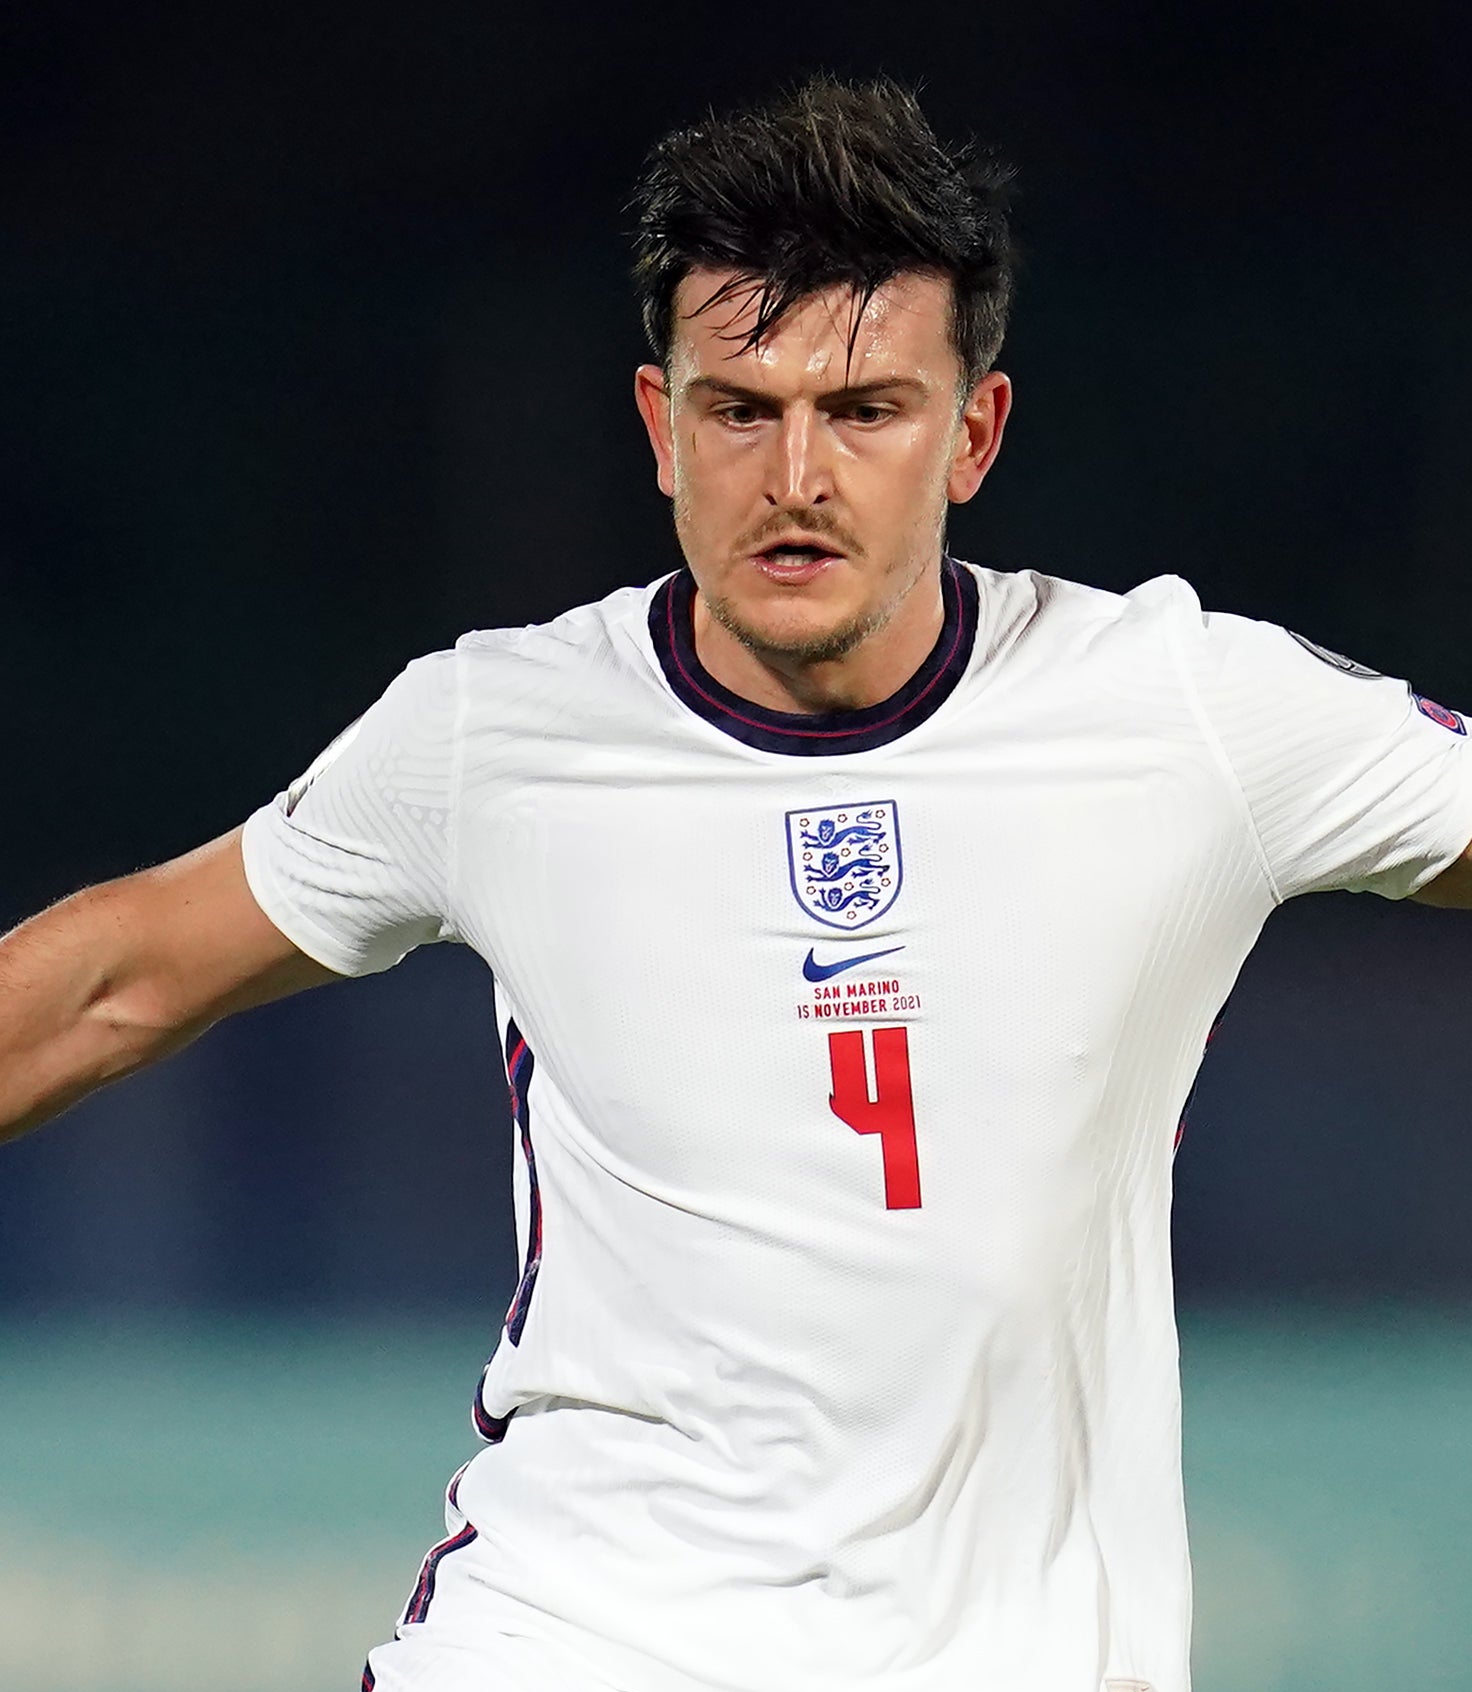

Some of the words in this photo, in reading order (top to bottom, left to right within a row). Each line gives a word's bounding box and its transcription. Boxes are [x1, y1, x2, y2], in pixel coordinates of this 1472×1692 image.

[814, 985, 841, 1000] SAN
[846, 979, 900, 998] MARINO
[797, 1004, 809, 1019] 15
[814, 999, 888, 1018] NOVEMBER
[892, 995, 921, 1011] 2021
[828, 1026, 922, 1210] 4
